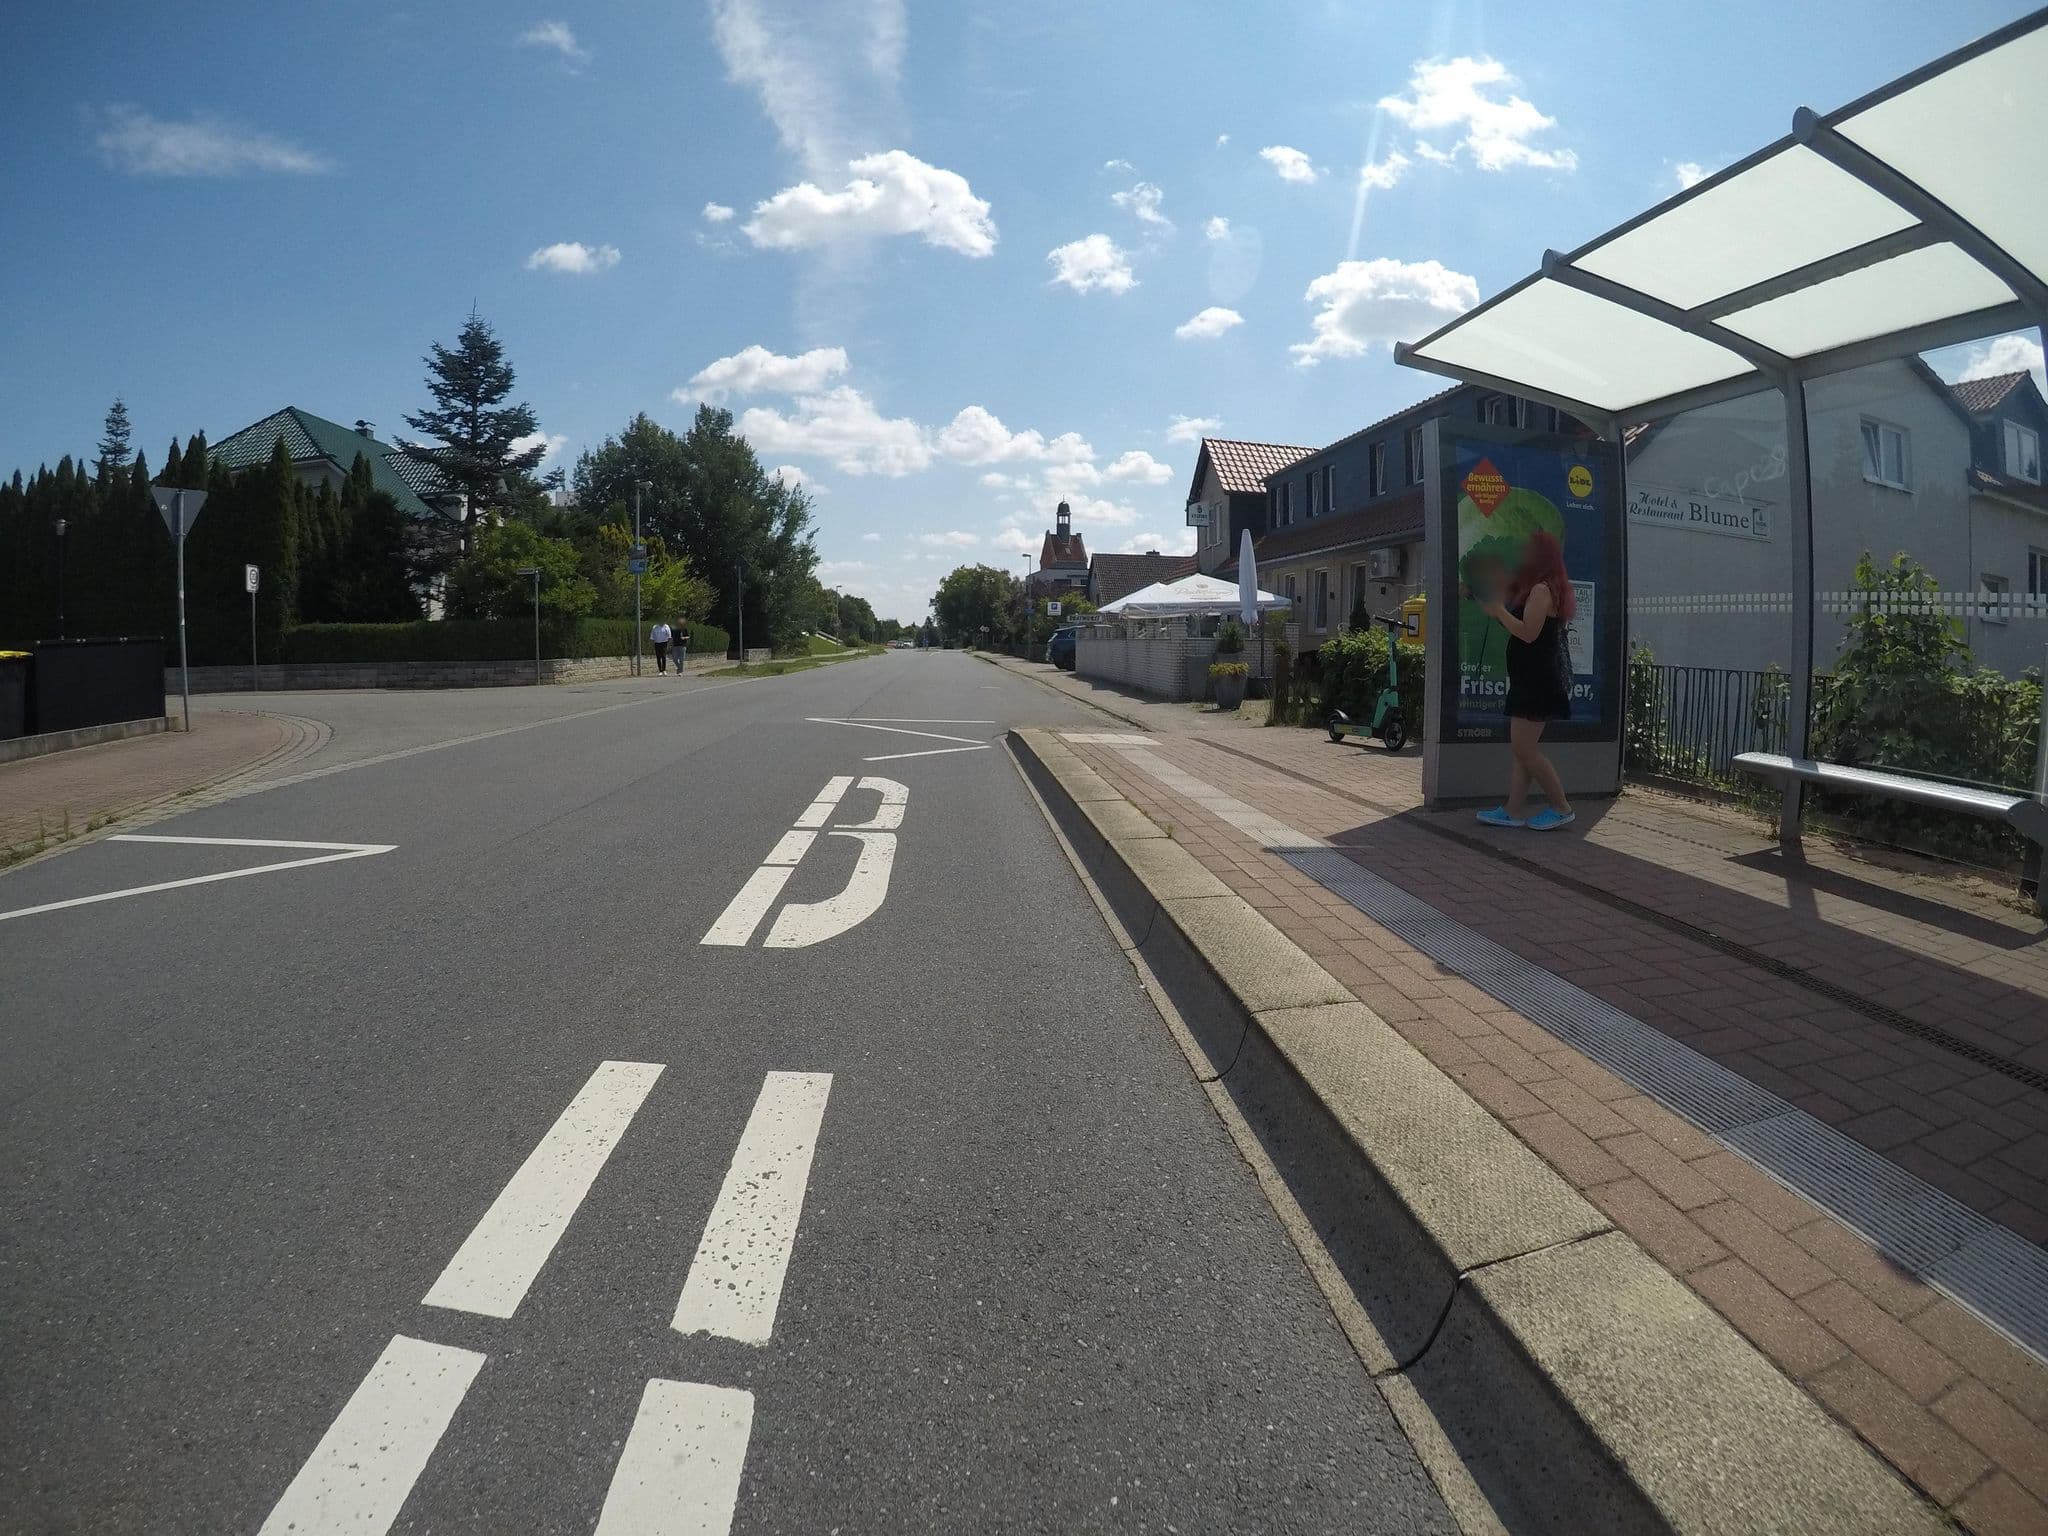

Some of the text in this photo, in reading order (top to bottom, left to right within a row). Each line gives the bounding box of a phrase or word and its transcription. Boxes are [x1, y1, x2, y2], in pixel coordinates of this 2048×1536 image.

[1468, 472, 1504, 483] Bewusst
[1466, 482, 1506, 493] ernähren
[1639, 491, 1670, 507] Hotel
[1628, 503, 1685, 522] Restaurant
[1688, 502, 1750, 529] Blume
